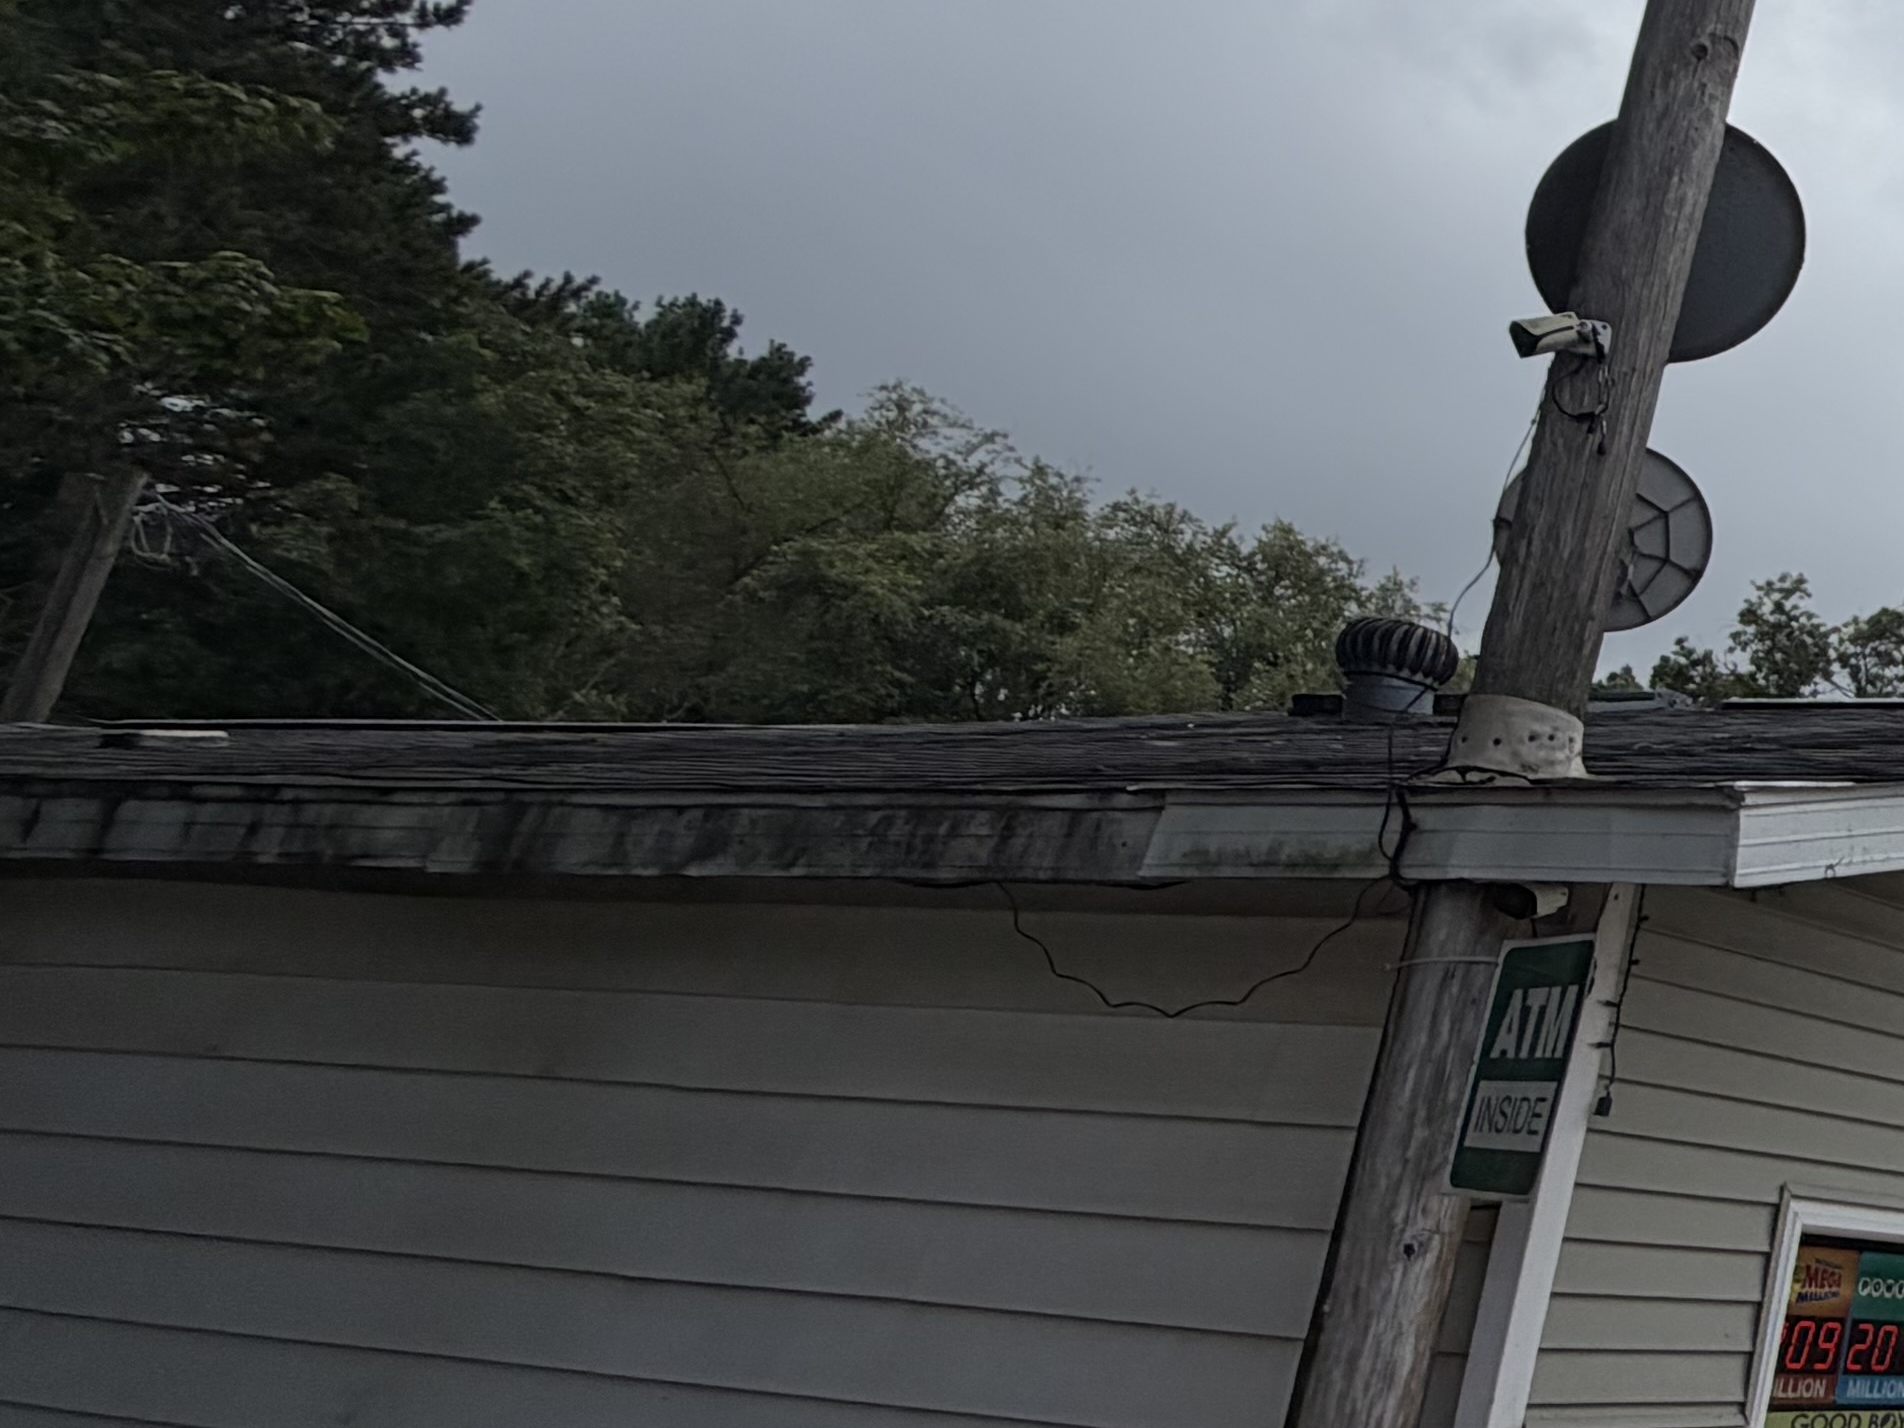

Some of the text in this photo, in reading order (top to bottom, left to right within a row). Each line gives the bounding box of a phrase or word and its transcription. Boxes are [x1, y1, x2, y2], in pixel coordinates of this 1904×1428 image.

[1489, 984, 1580, 1060] ATM
[1473, 1095, 1548, 1136] INSIDE
[1781, 1320, 1842, 1370] 09
[1773, 1377, 1828, 1399] ILLION
